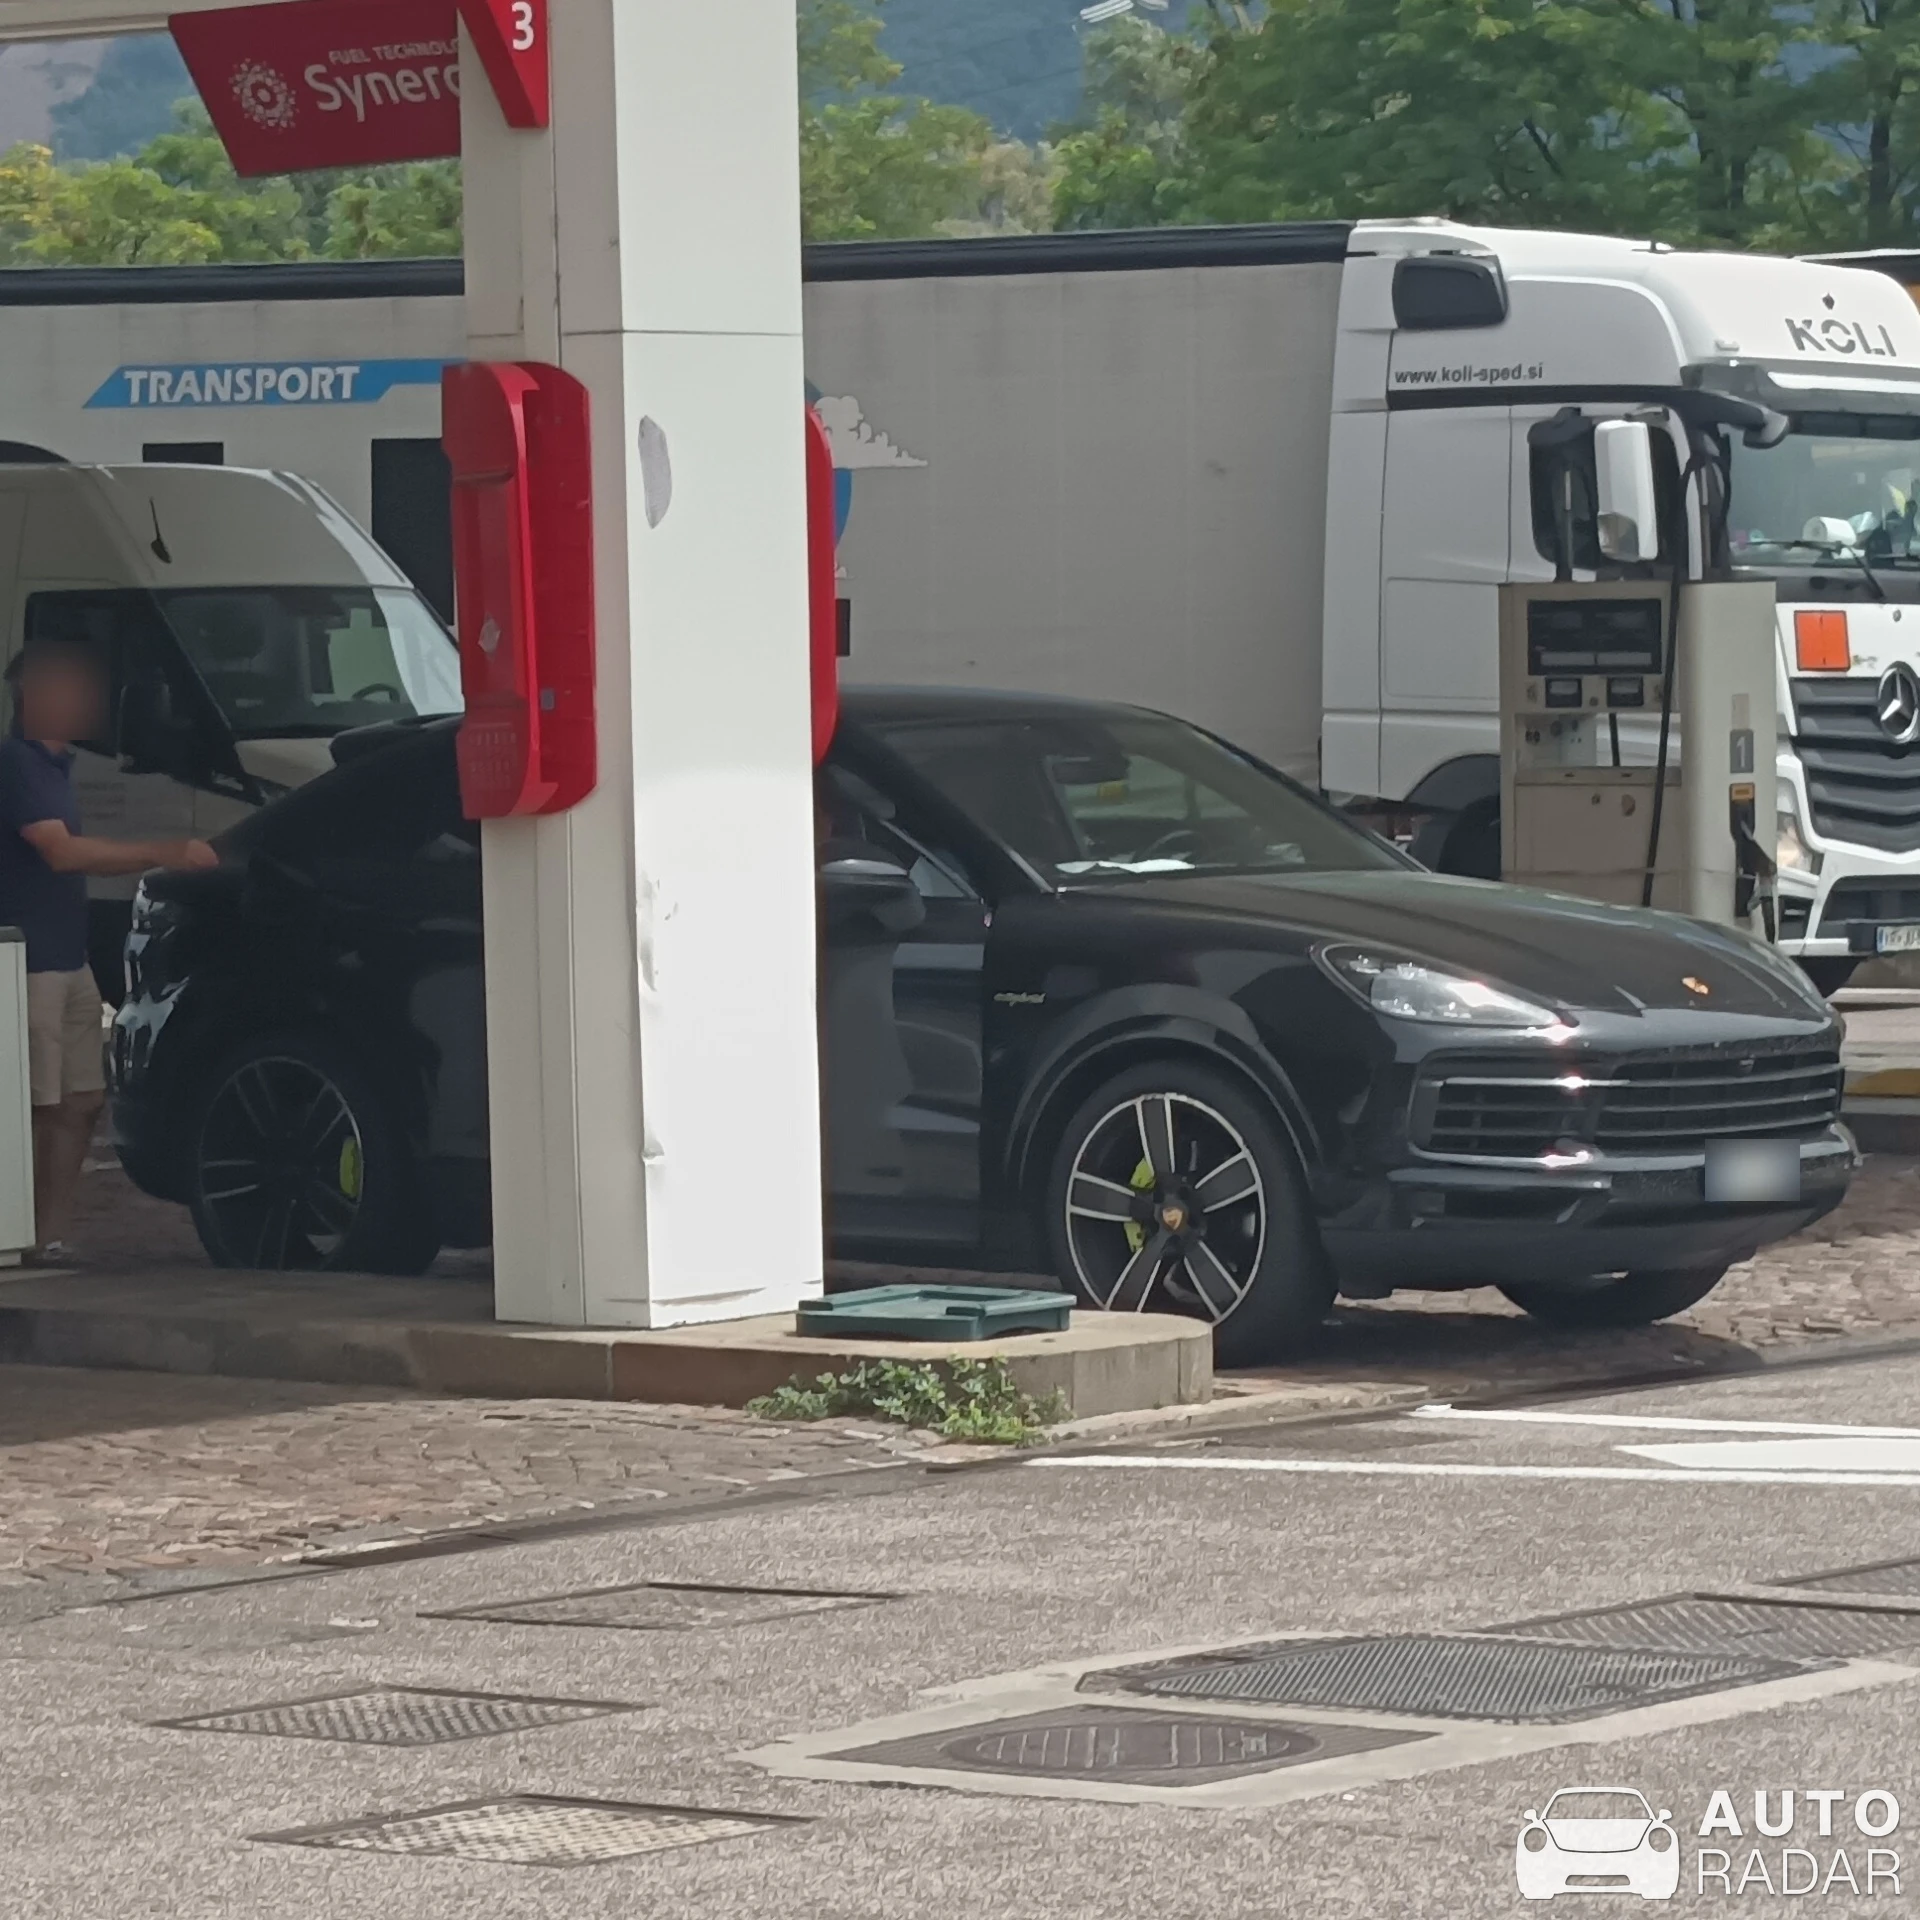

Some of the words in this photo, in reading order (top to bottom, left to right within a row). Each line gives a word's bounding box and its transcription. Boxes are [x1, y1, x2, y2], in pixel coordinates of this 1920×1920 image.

[511, 2, 535, 50] 3
[328, 48, 371, 65] FUEL
[1785, 318, 1897, 357] KOLI
[124, 366, 360, 404] TRANSPORT
[1394, 361, 1544, 385] www.koli-sped.si
[1736, 736, 1746, 768] 1
